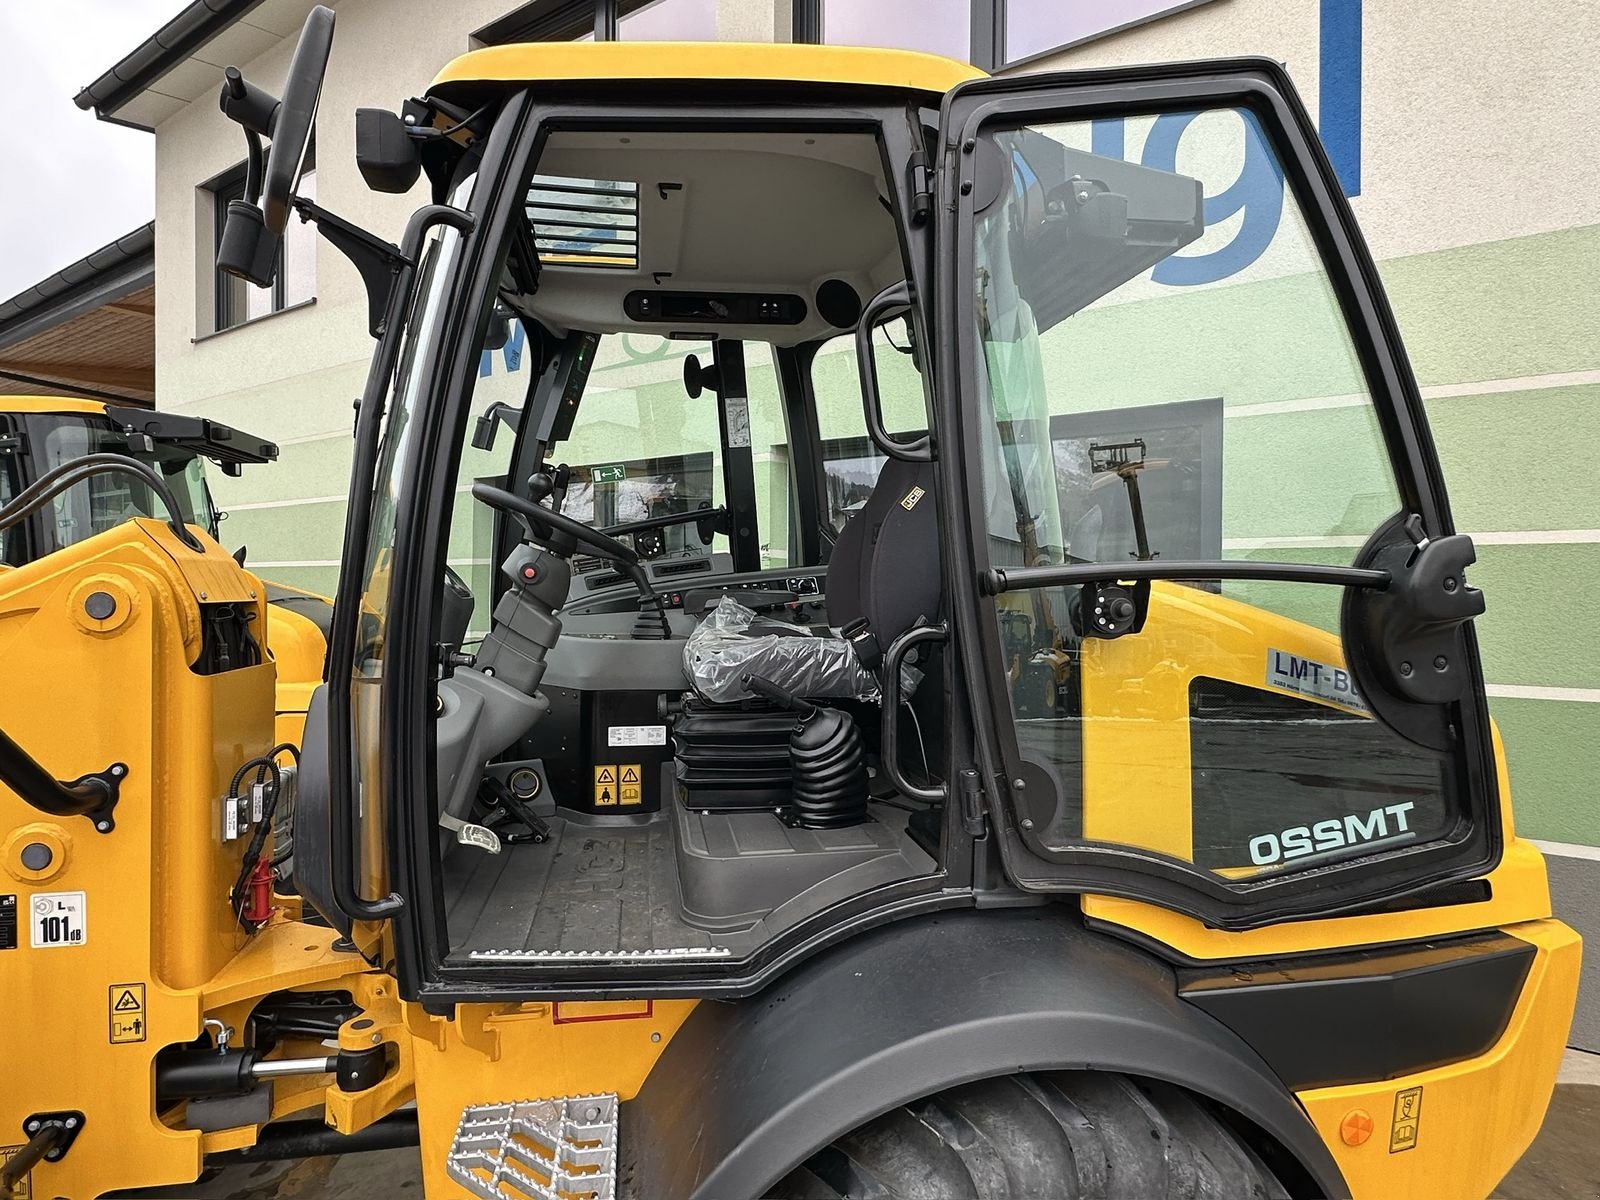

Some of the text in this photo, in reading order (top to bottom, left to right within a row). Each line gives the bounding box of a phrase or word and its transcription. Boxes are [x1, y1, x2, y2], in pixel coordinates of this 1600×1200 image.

[903, 489, 922, 508] JCB
[40, 916, 81, 942] 101 dB
